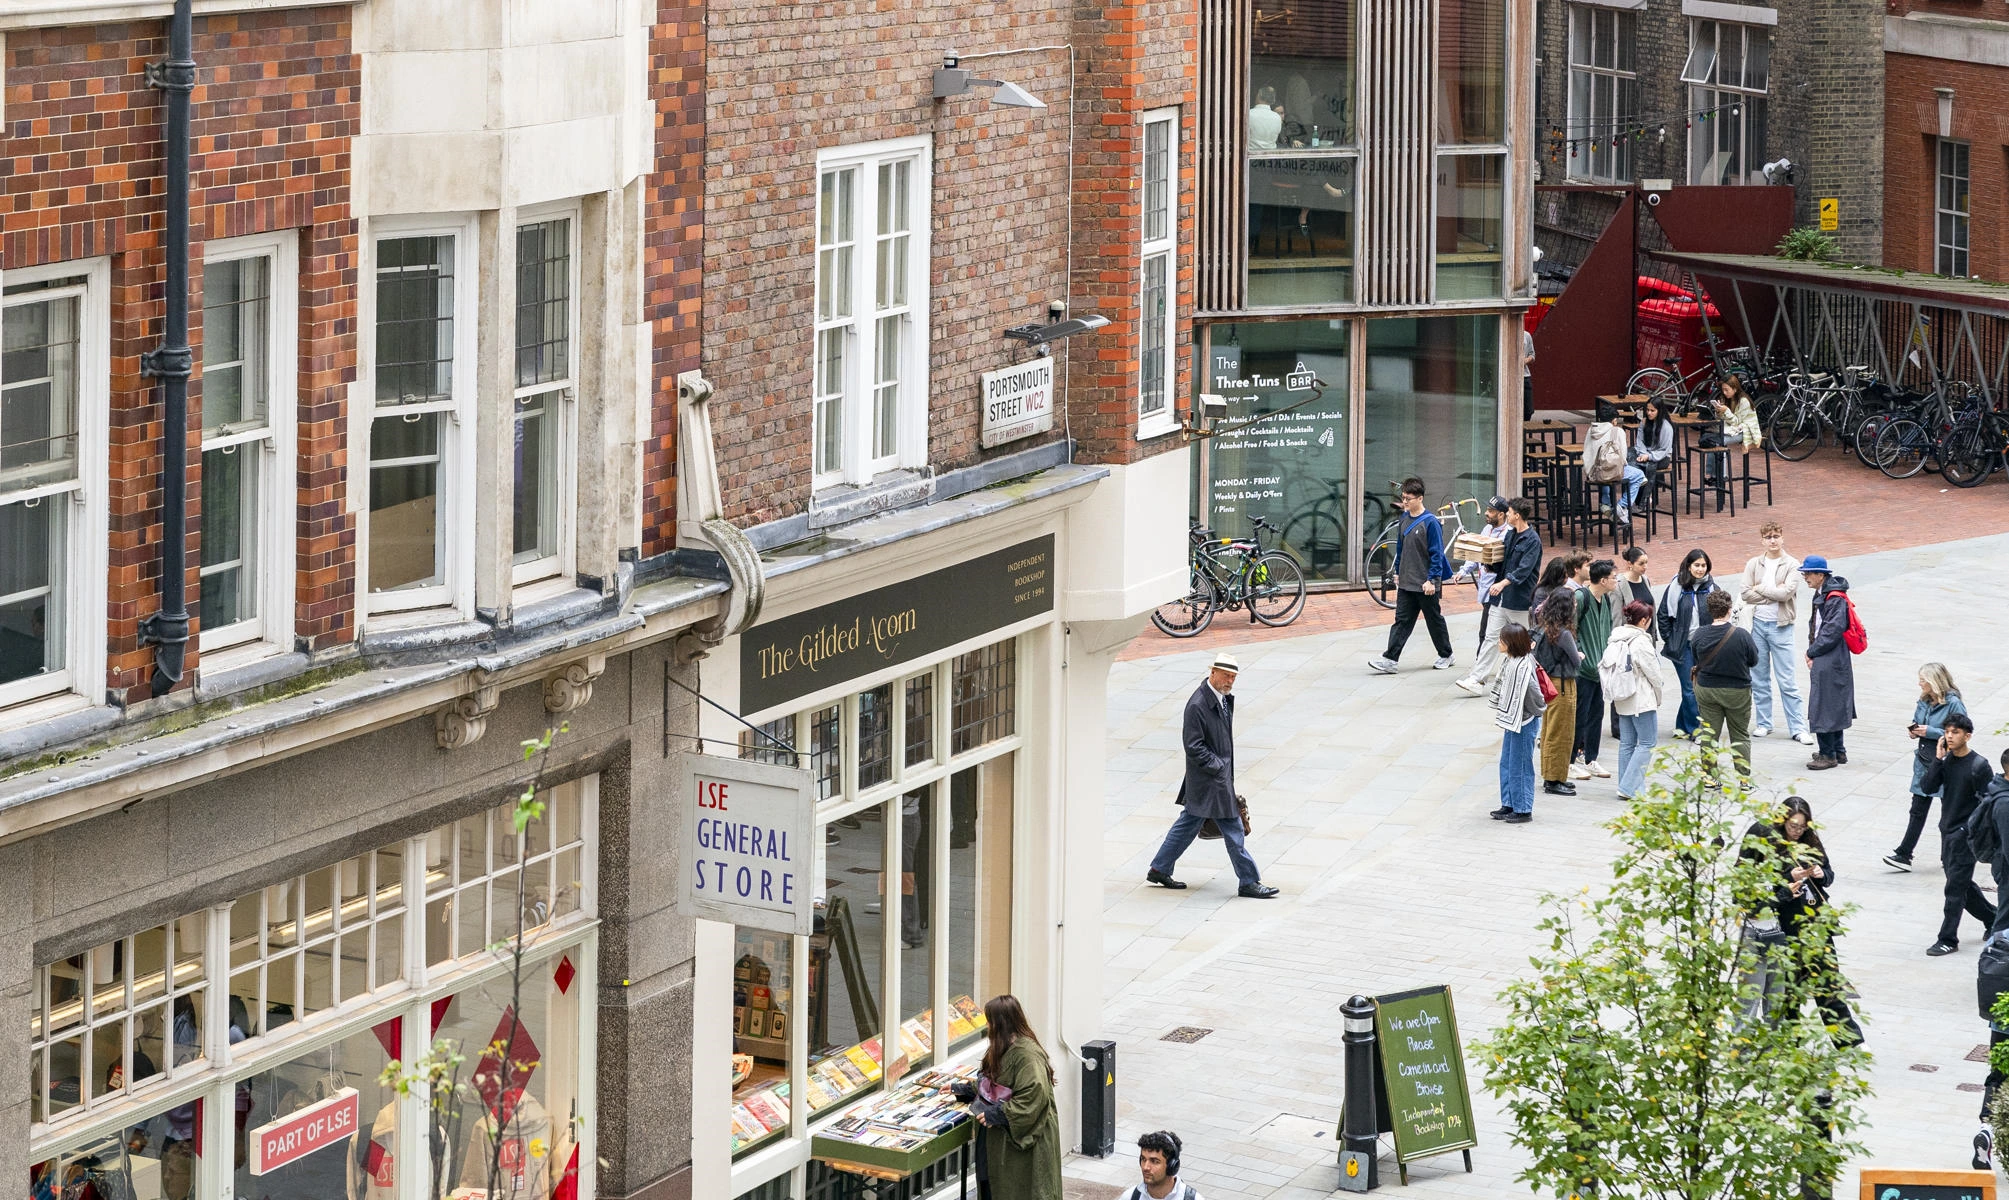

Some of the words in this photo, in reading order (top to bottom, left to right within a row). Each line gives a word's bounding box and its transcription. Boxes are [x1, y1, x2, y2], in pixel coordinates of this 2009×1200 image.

[1216, 356, 1238, 370] The
[990, 366, 1049, 399] PORTSMOUTH
[1216, 375, 1250, 389] Three
[1252, 374, 1280, 387] Tuns
[1290, 376, 1312, 387] BAR
[990, 397, 1022, 422] STREET
[1025, 390, 1044, 412] WC2
[1229, 415, 1248, 423] Music
[1278, 413, 1290, 421] DJs
[1321, 411, 1343, 420] Socials
[988, 432, 998, 443] CITY
[1000, 431, 1005, 440] OF
[1005, 423, 1034, 438] WESTMINSTER
[1250, 427, 1279, 435] Cocktails
[1284, 425, 1314, 433] Mocktails
[1219, 441, 1243, 449] Alcohol
[1263, 439, 1279, 447] Food
[1286, 438, 1308, 446] Snacks
[1214, 478, 1248, 487] MONDAY
[1253, 477, 1281, 485] FRIDAY
[1214, 492, 1237, 501] Weekly
[1238, 491, 1244, 499] &
[1245, 490, 1261, 500] Daily
[1219, 505, 1235, 513] Pints
[1007, 553, 1045, 572] INDEPENDENT
[1015, 570, 1045, 587] BOOKSHOP
[1014, 591, 1030, 603] SINCE
[1032, 587, 1045, 597] 1994
[758, 643, 799, 679] The
[799, 616, 860, 672] Gilded
[866, 608, 917, 660] Acorn
[698, 780, 729, 811] LSE
[697, 818, 791, 862] GENERAL
[695, 859, 793, 905] STORE
[1388, 1016, 1403, 1031] We
[1406, 1018, 1420, 1029] are
[1420, 1009, 1441, 1033] Open
[1407, 1036, 1435, 1052] Please
[1398, 1062, 1422, 1076] Come
[1423, 1062, 1432, 1074] in
[1432, 1054, 1450, 1073] and
[1415, 1081, 1444, 1096] Browse
[1401, 1102, 1445, 1123] Independent
[267, 1127, 304, 1160] PART
[307, 1118, 325, 1142] OF
[327, 1106, 351, 1133] LSE
[1414, 1121, 1445, 1139] Bookshop
